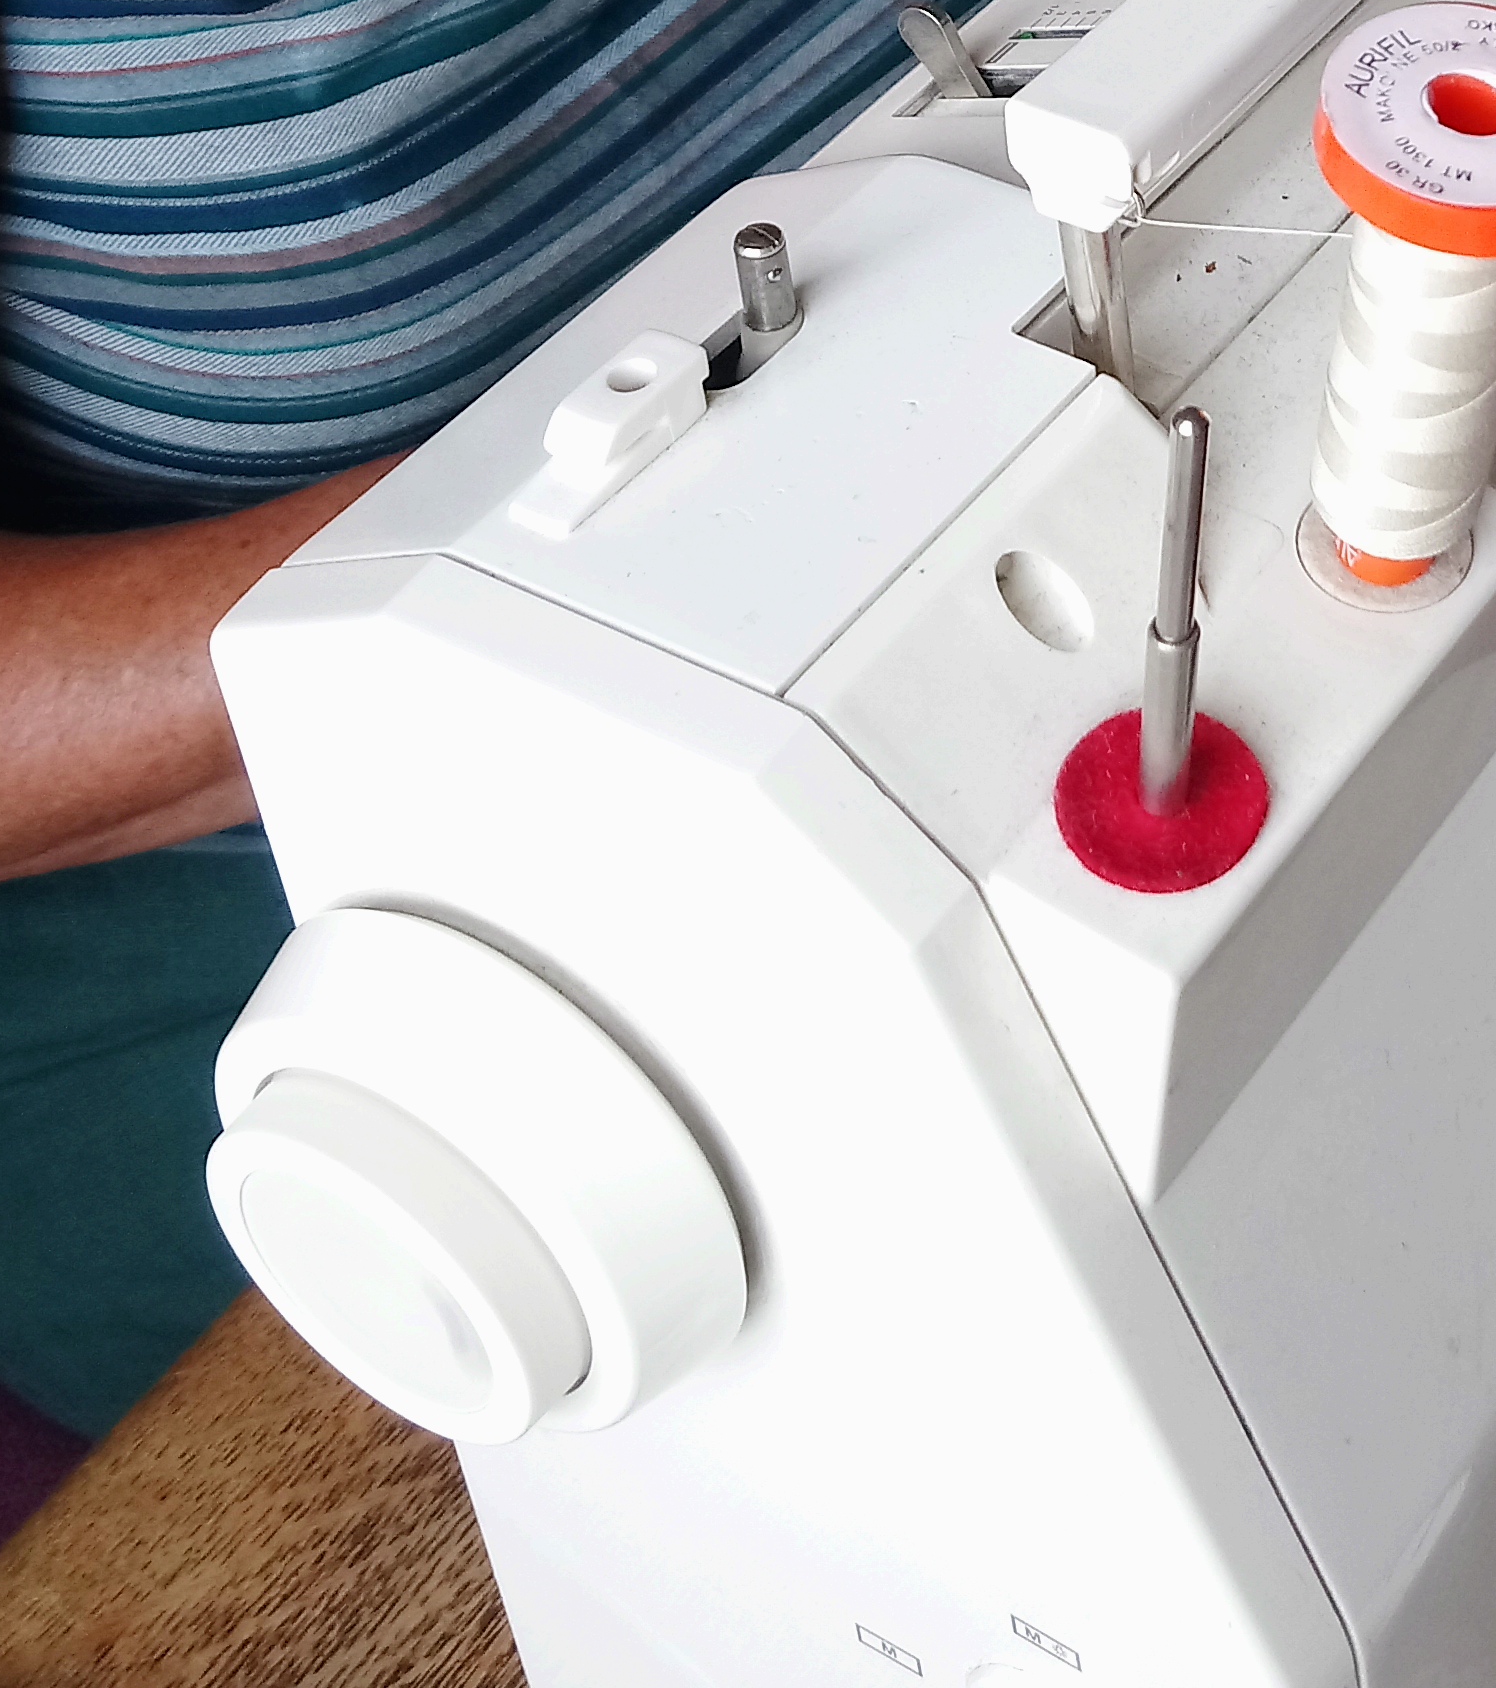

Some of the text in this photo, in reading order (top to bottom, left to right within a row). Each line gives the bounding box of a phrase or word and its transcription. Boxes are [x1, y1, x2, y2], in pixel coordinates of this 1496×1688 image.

[1343, 29, 1423, 99] AURIFIL
[1392, 51, 1419, 71] NE
[1394, 135, 1474, 182] MT 1300
[1385, 159, 1445, 195] GR 30
[1025, 1626, 1041, 1644] M
[881, 1641, 897, 1659] M
